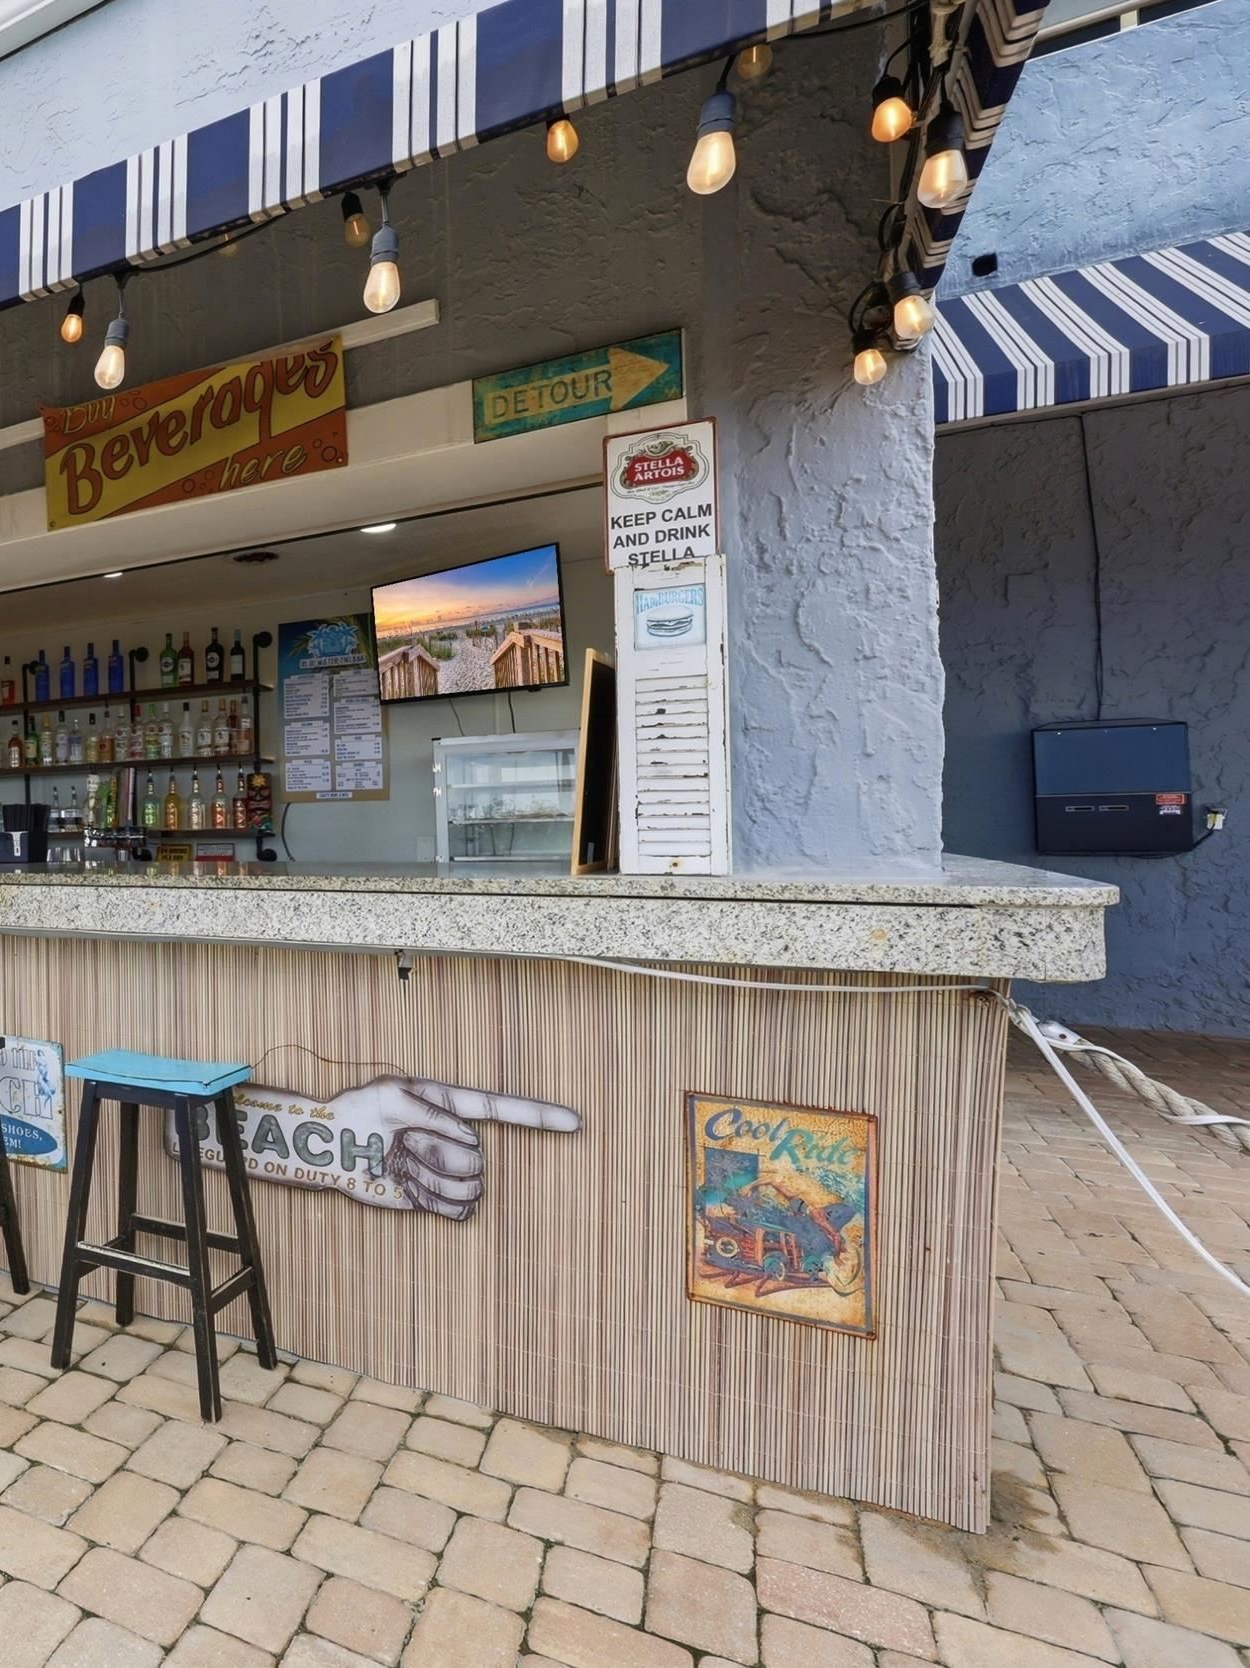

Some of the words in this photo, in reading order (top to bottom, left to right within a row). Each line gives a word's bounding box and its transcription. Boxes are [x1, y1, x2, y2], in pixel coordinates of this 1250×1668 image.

[491, 368, 614, 420] DETOUR
[59, 340, 338, 515] Beverages
[61, 396, 116, 435] Buy
[218, 444, 308, 490] here
[633, 465, 685, 481] ARTOIS
[634, 456, 684, 473] STELLA
[610, 511, 657, 530] KEEP
[661, 503, 712, 522] CALM
[613, 532, 650, 549] AND
[654, 523, 711, 544] DRINK
[628, 546, 695, 566] STELLA
[636, 588, 704, 614] HAMBURGERS
[11, 1046, 36, 1071] THE
[233, 1093, 283, 1112] lcome
[288, 1103, 304, 1115] to
[310, 1105, 335, 1120] the
[704, 1108, 789, 1141] Cool
[769, 1127, 857, 1165] Ride
[264, 1161, 288, 1176] ON
[294, 1167, 342, 1186] DUTY
[347, 1178, 357, 1190] 8
[363, 1180, 387, 1196] TO
[393, 1185, 404, 1199] 5
